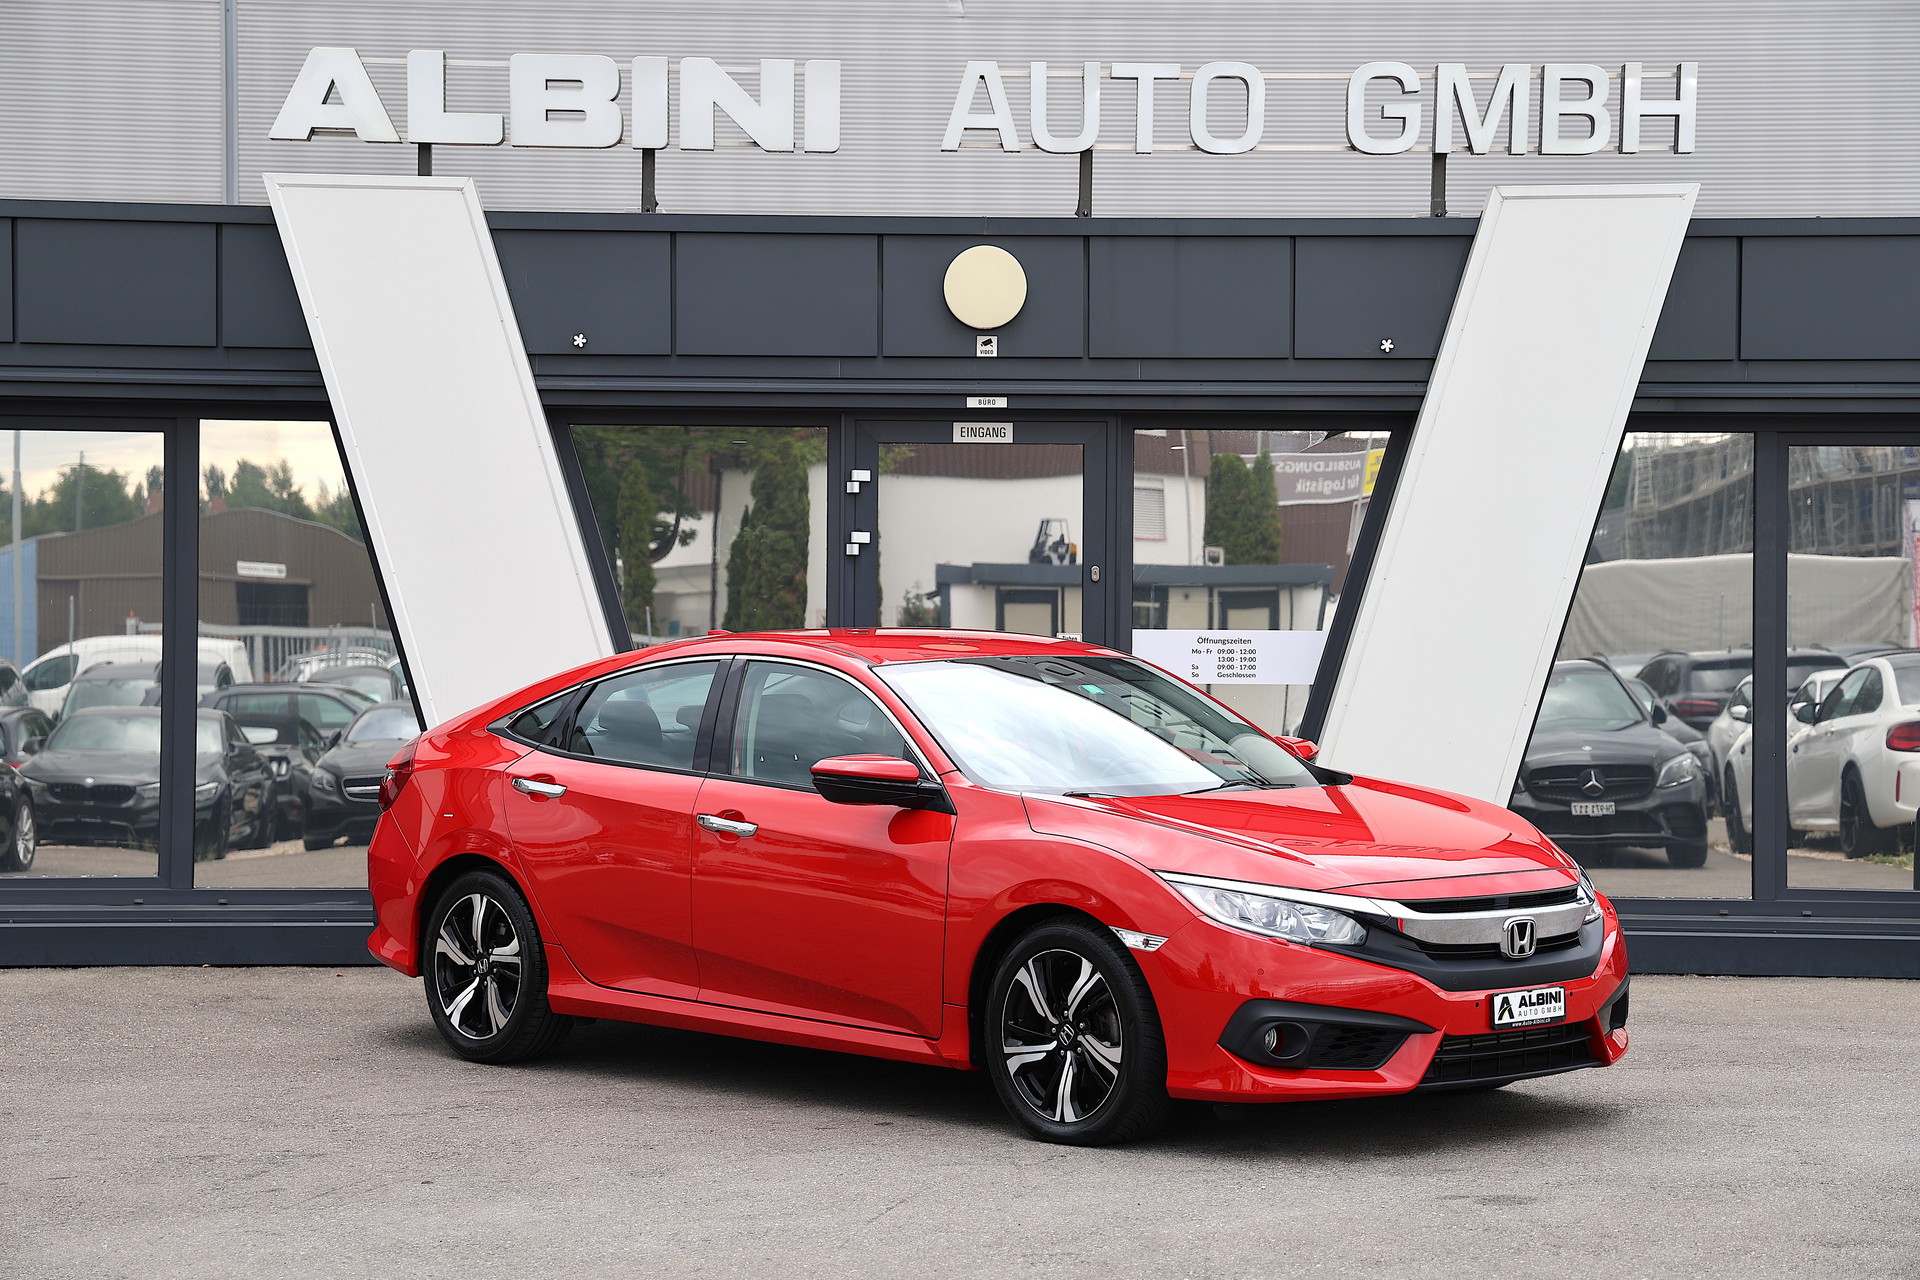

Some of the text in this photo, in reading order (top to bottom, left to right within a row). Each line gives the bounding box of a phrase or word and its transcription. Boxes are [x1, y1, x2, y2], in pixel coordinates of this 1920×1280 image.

[268, 46, 1698, 156] ALBINI AUTO GMBH
[978, 398, 996, 406] BÜRO
[960, 426, 1007, 438] EINGANG
[1197, 636, 1252, 645] Öffnungszeiten
[1518, 991, 1561, 1008] ALBINI
[1518, 1005, 1562, 1017] AUTO GMBH
